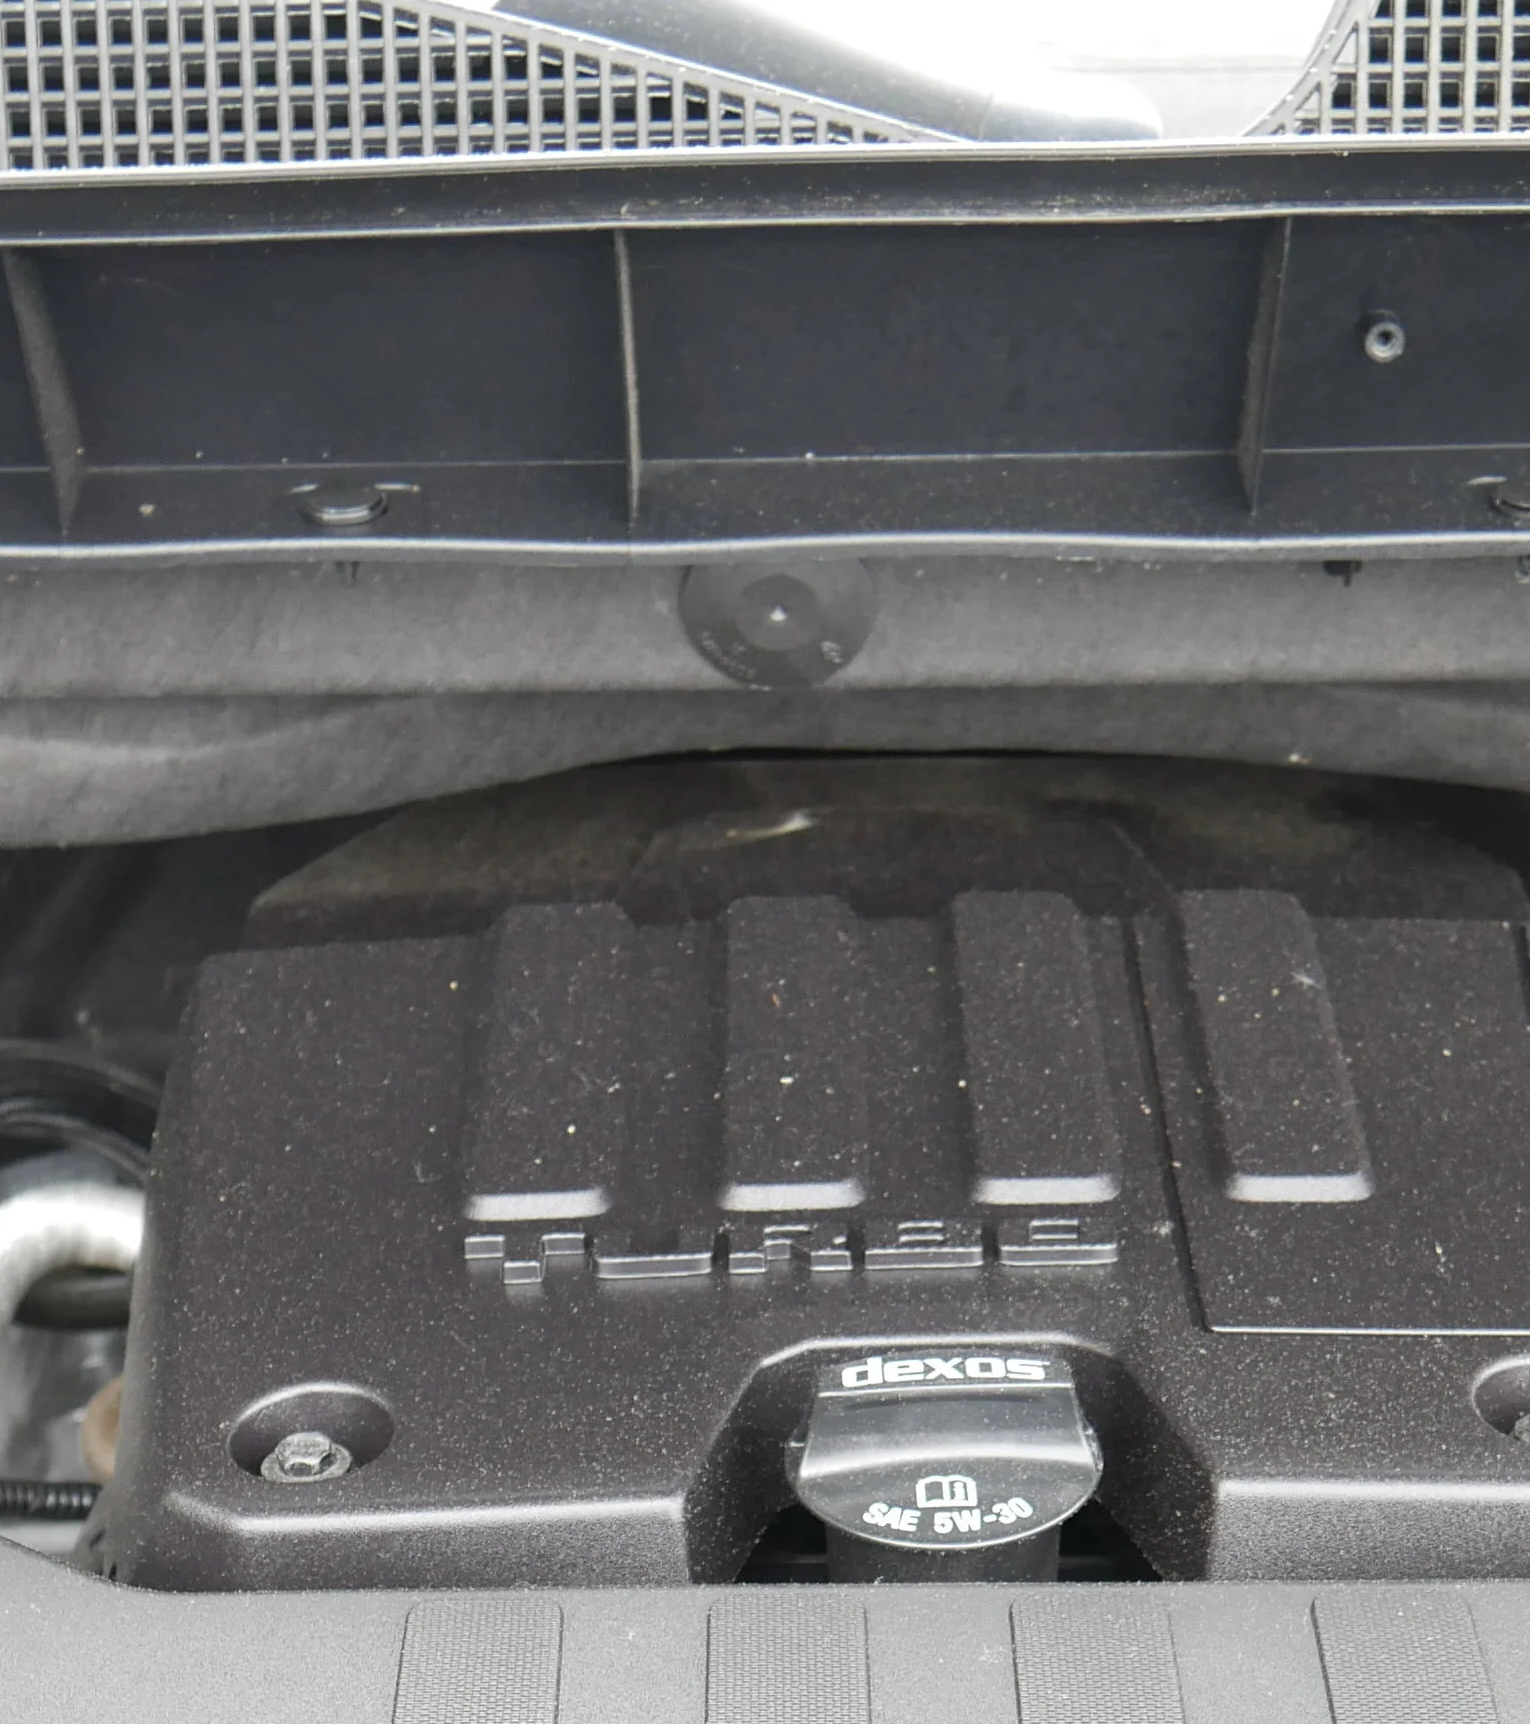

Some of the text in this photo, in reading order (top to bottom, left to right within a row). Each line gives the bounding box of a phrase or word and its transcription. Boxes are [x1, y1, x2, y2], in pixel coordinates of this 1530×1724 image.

[841, 1356, 1051, 1388] dexos
[862, 1497, 1034, 1534] SAE 5W-30
